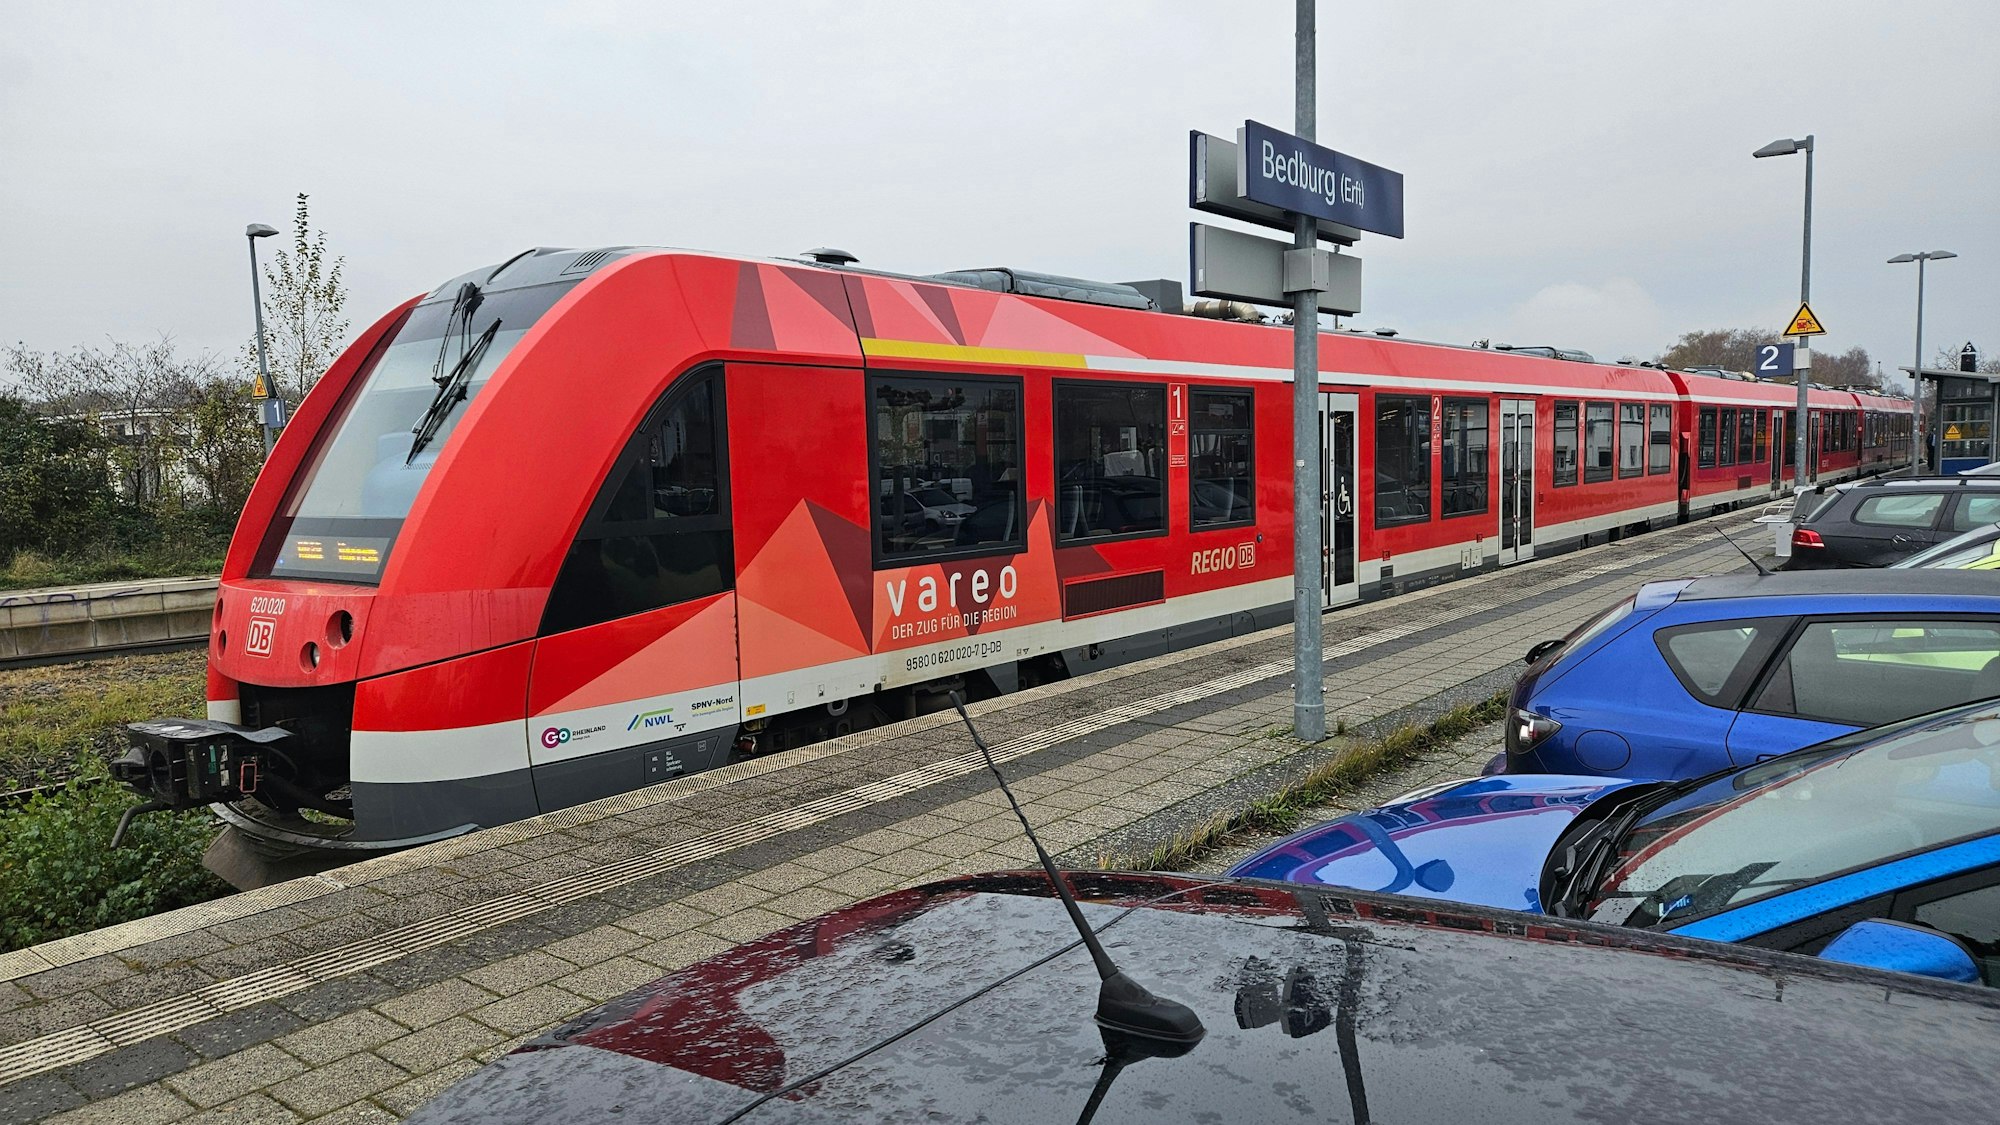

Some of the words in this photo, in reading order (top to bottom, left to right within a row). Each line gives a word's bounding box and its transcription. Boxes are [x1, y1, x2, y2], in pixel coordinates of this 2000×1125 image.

[1262, 139, 1335, 206] Bedburg
[1340, 172, 1365, 209] (Erft)
[1760, 345, 1779, 371] 2
[274, 401, 280, 422] 1
[1172, 386, 1181, 418] 1
[1433, 396, 1440, 420] 2
[1191, 547, 1236, 575] REGIO
[1240, 545, 1254, 567] DB
[886, 565, 1017, 617] vareo
[892, 623, 913, 640] DER
[916, 617, 938, 636] ZUG
[941, 612, 960, 631] FÜR
[963, 611, 979, 627] DIE
[982, 605, 1017, 623] REGION
[247, 620, 274, 654] DB
[938, 648, 954, 663] 620
[956, 644, 979, 660] 020-7
[981, 640, 1002, 658] D-DB
[691, 695, 734, 710] SPNV-Nord
[572, 725, 606, 736] RHEINLAND
[645, 714, 674, 728] NWL
